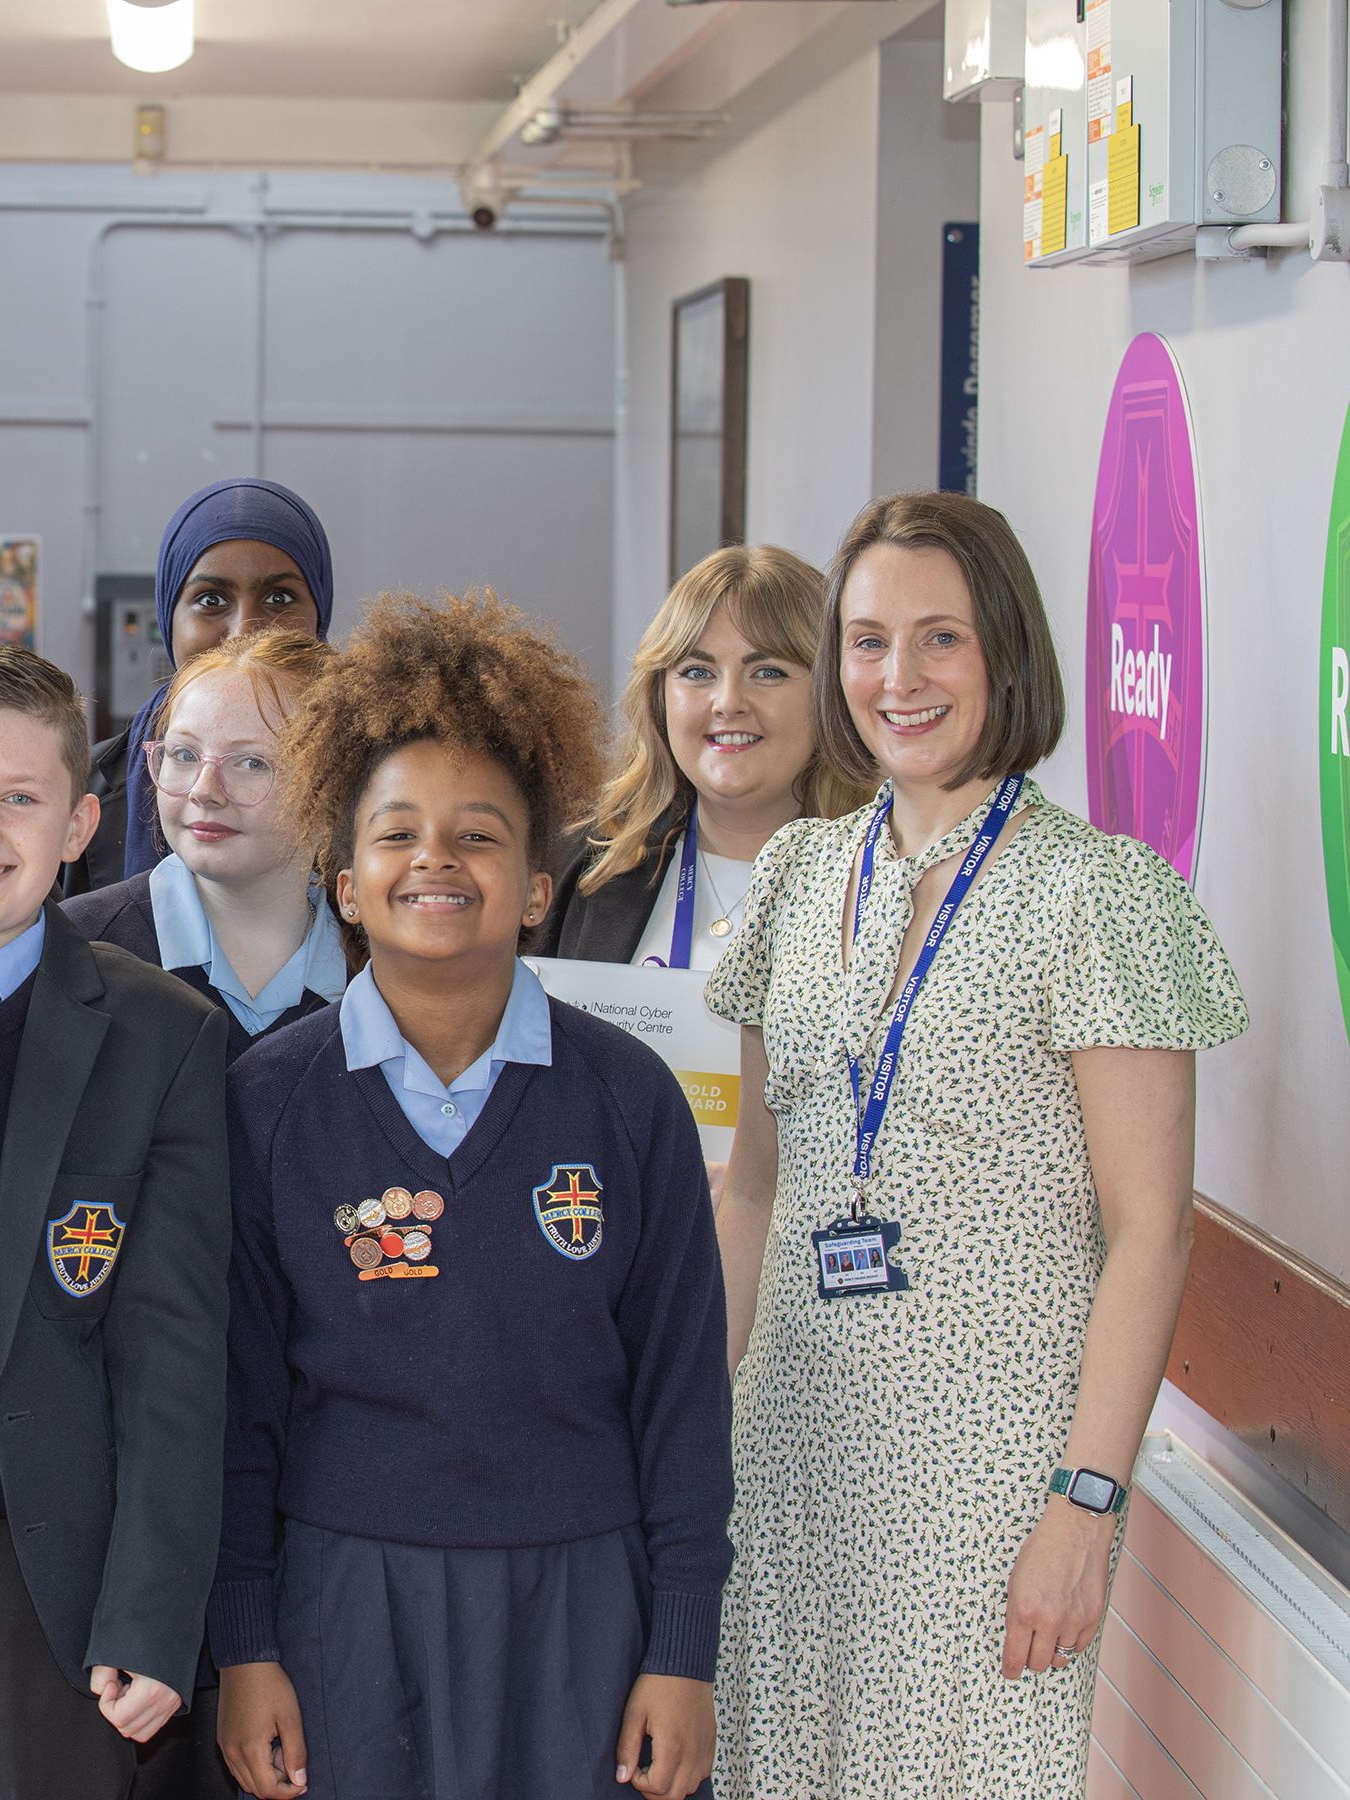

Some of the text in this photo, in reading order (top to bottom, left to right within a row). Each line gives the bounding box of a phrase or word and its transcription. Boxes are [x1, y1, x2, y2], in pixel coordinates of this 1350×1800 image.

[1110, 622, 1172, 741] Ready
[996, 778, 1020, 812] VISITOR
[866, 806, 887, 848] VISITOR
[961, 835, 992, 877] VISITOR
[857, 874, 870, 922] VISITOR
[926, 903, 954, 948] VISITOR
[593, 1002, 673, 1019] National Cyber
[894, 975, 920, 1023] VISITOR
[637, 1020, 673, 1035] Centre
[873, 1052, 894, 1101] VISITOR
[689, 1097, 728, 1111] ARD
[859, 1132, 873, 1178] VISITOR
[542, 1208, 571, 1221] MERCY
[54, 1246, 115, 1258] MERCY COLLEGE
[547, 1223, 601, 1255] TRUTH LOVE JUSTIC
[824, 1239, 861, 1248] Safeguarding
[56, 1258, 110, 1291] TRUTH LOVE JUSTICE
[373, 1267, 393, 1277] GOLD
[403, 1268, 423, 1276] GOLD
